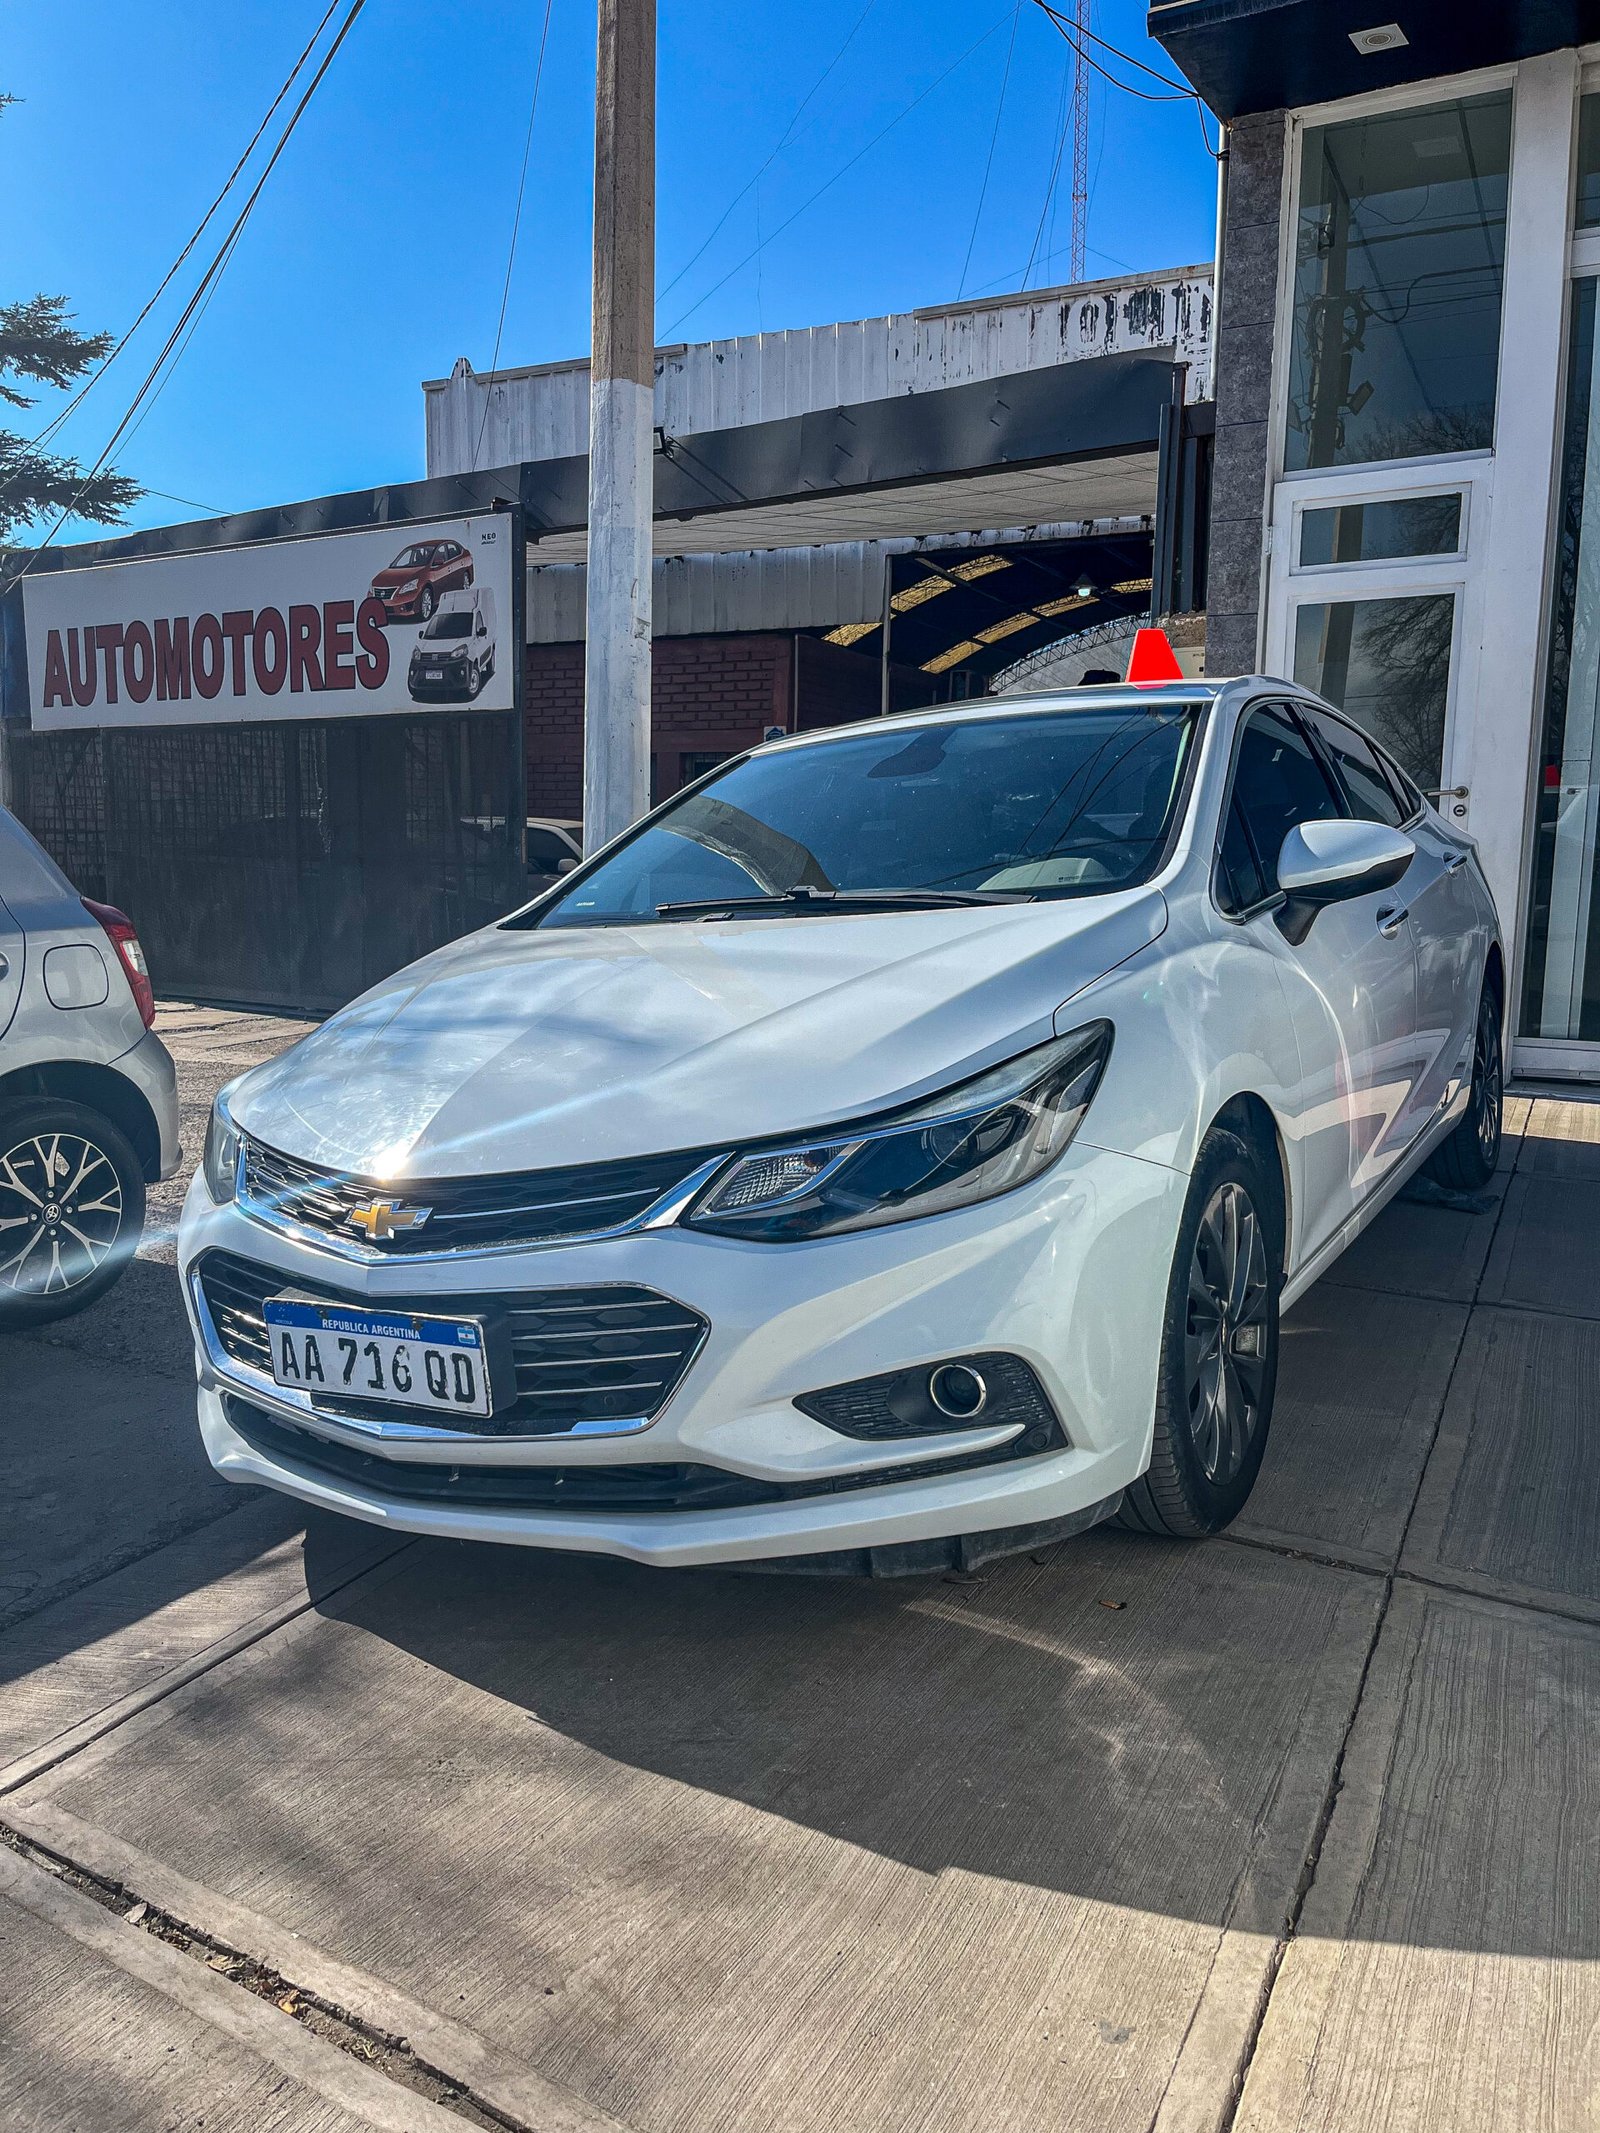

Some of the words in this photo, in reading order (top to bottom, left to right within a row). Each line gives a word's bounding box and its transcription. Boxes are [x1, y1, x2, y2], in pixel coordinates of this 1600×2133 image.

[44, 597, 390, 707] AUTOMOTORES
[322, 1318, 369, 1334] REPUBLICA
[371, 1324, 421, 1340] ARGENTINA
[281, 1331, 325, 1383] AA
[338, 1337, 413, 1393] 716
[424, 1349, 476, 1404] QD
